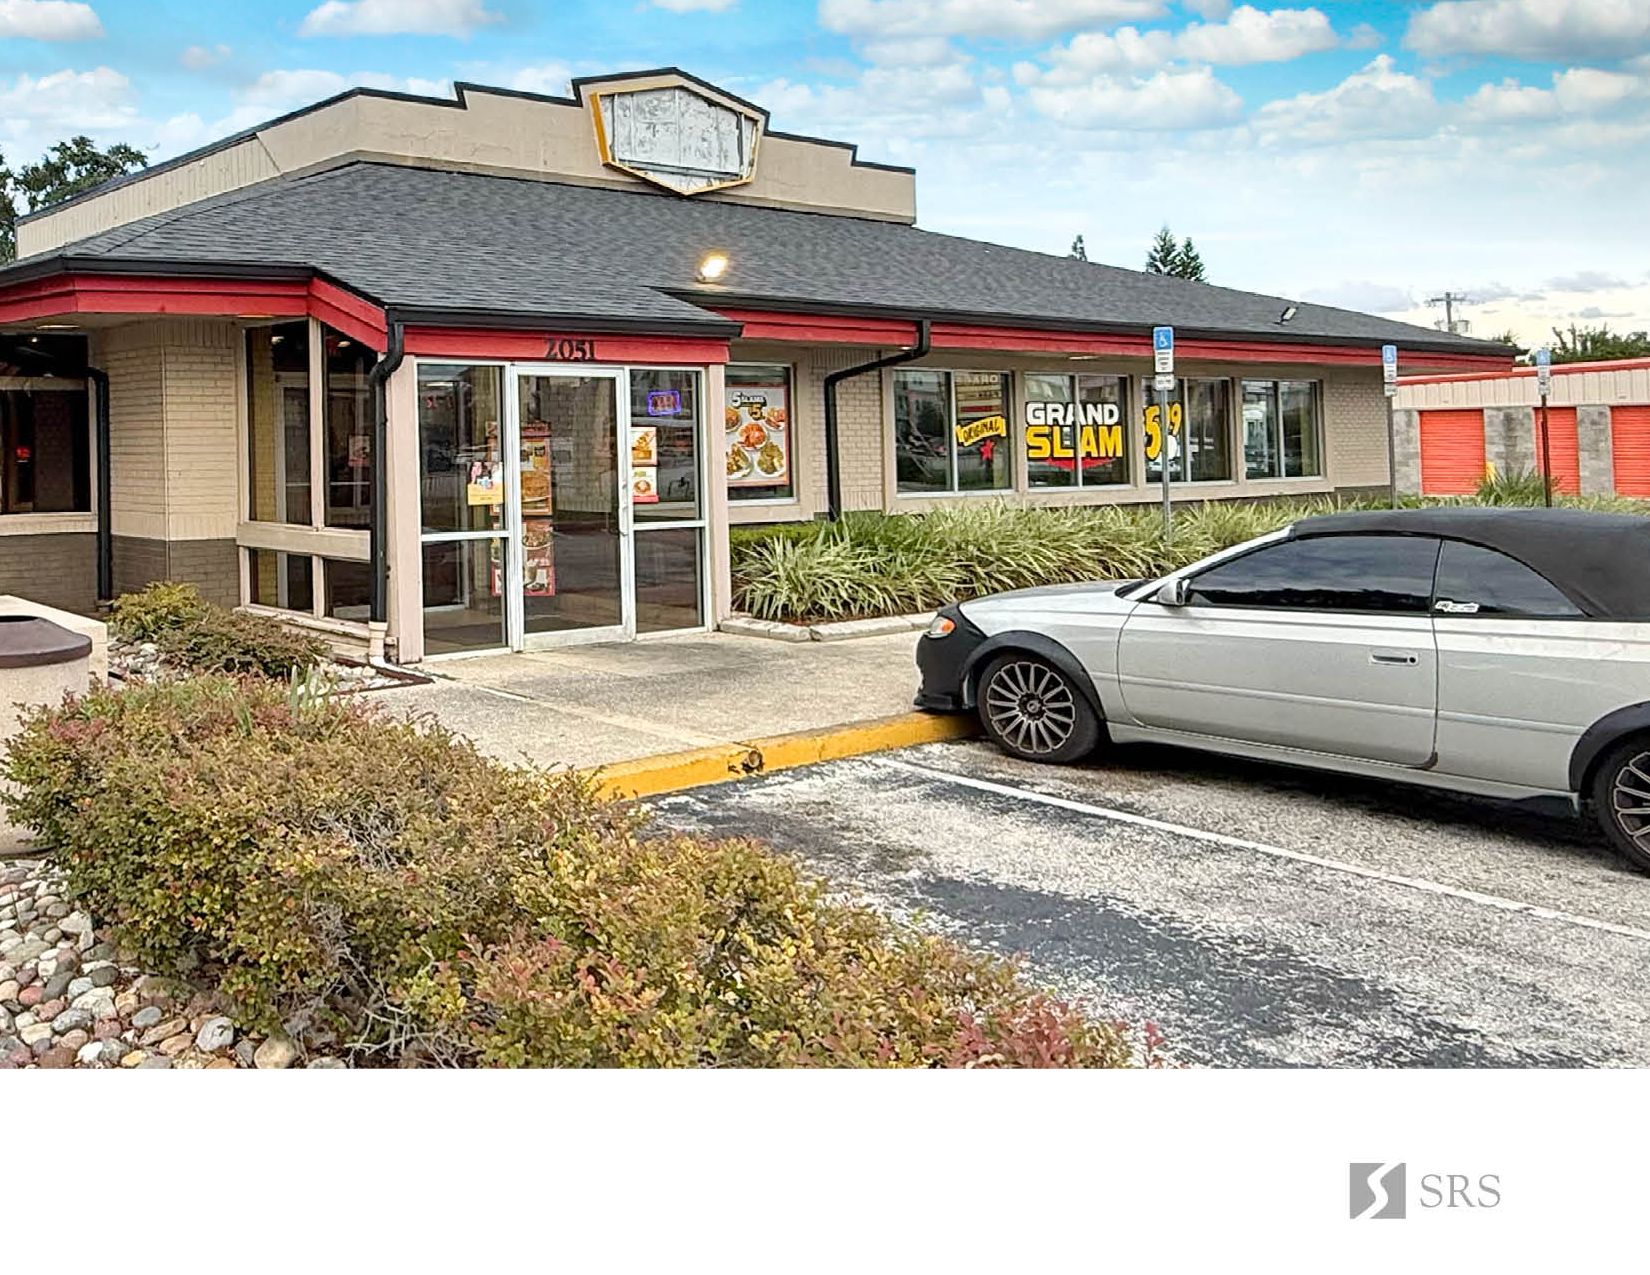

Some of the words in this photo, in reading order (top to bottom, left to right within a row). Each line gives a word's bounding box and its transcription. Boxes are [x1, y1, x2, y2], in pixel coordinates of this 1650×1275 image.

[544, 338, 596, 361] 2051
[1026, 402, 1120, 427] GRAND
[1026, 424, 1123, 458] SLAM
